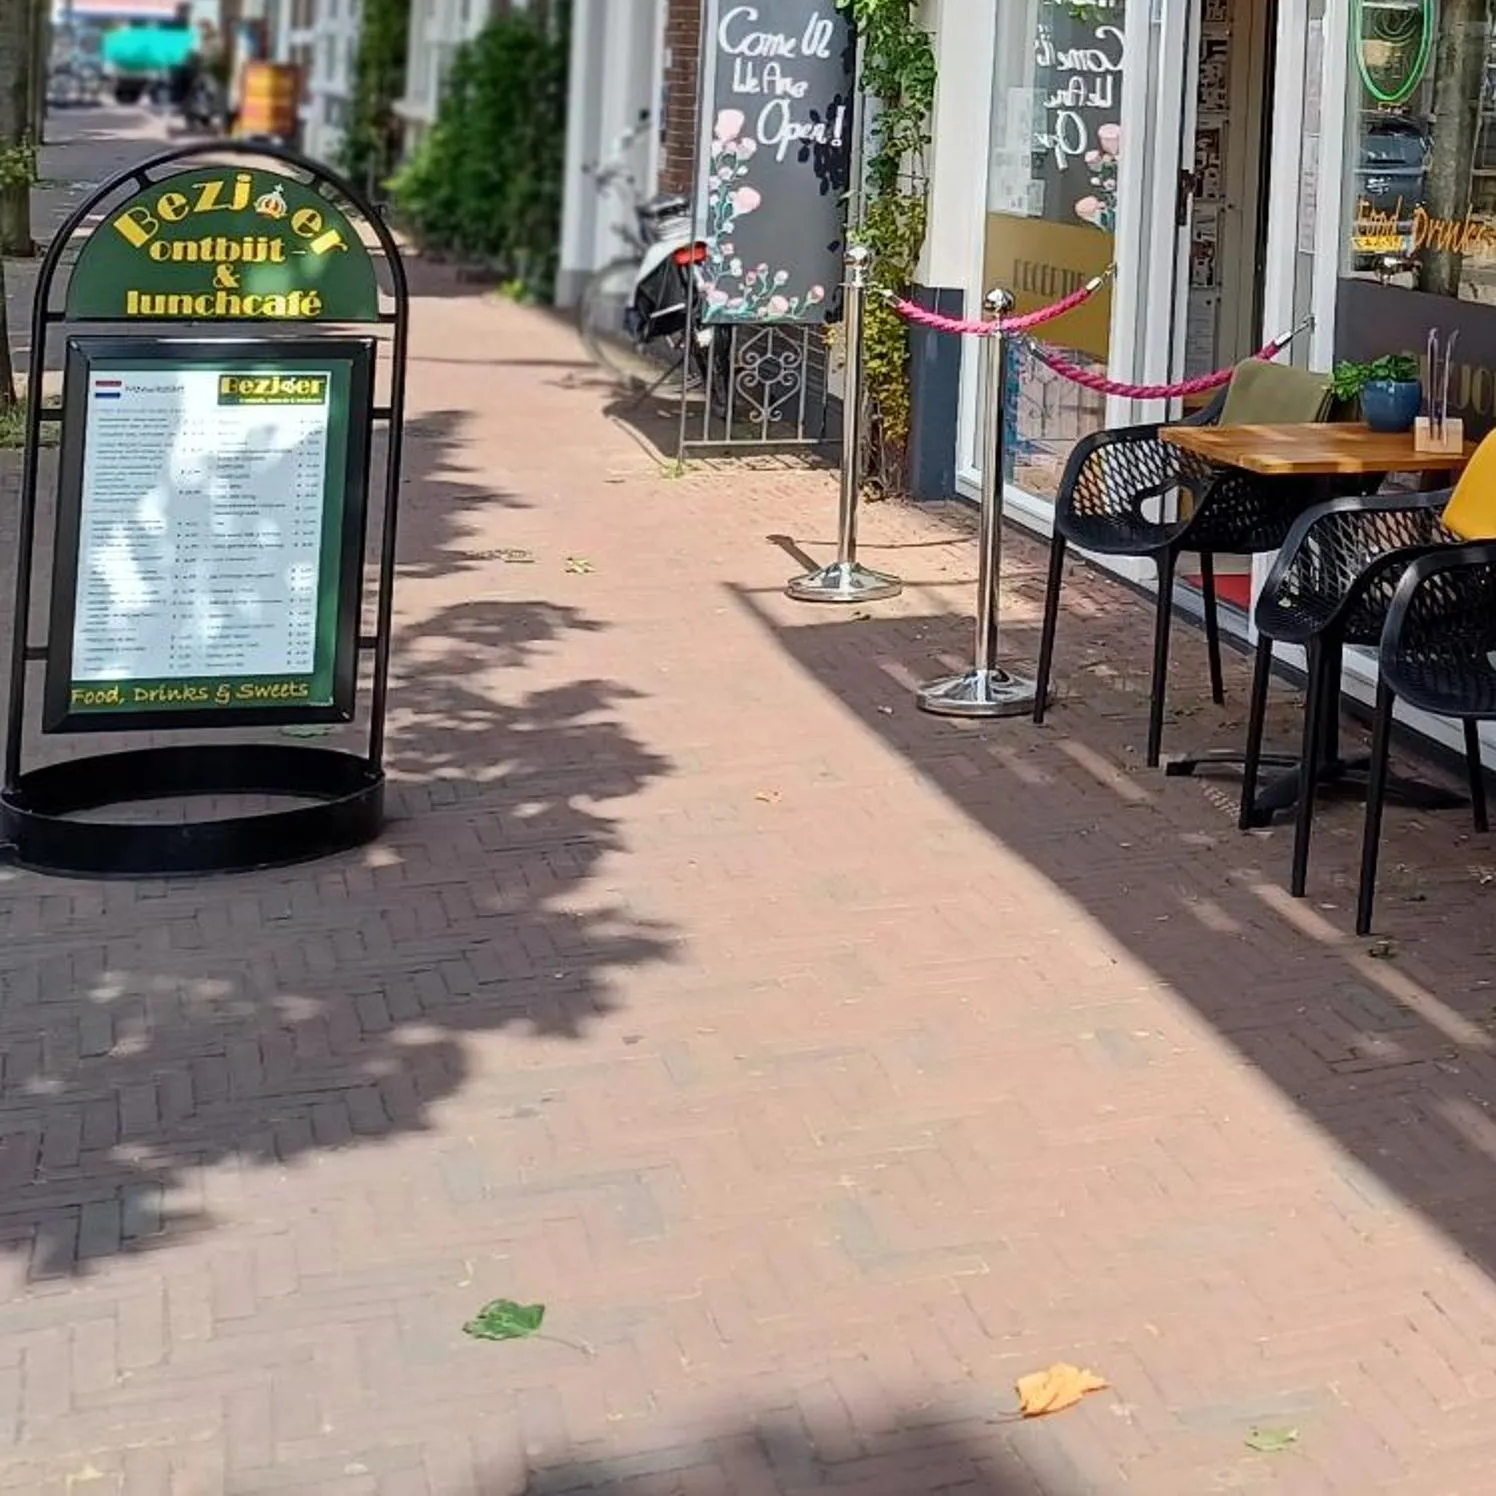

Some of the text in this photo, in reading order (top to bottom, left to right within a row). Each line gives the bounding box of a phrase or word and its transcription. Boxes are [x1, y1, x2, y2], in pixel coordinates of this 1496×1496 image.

[717, 5, 797, 59] Come
[149, 236, 287, 265] ontbijt
[212, 264, 241, 289] &
[126, 290, 323, 318] lunchcafé
[71, 681, 309, 705] Food, Drinks & Sweets
